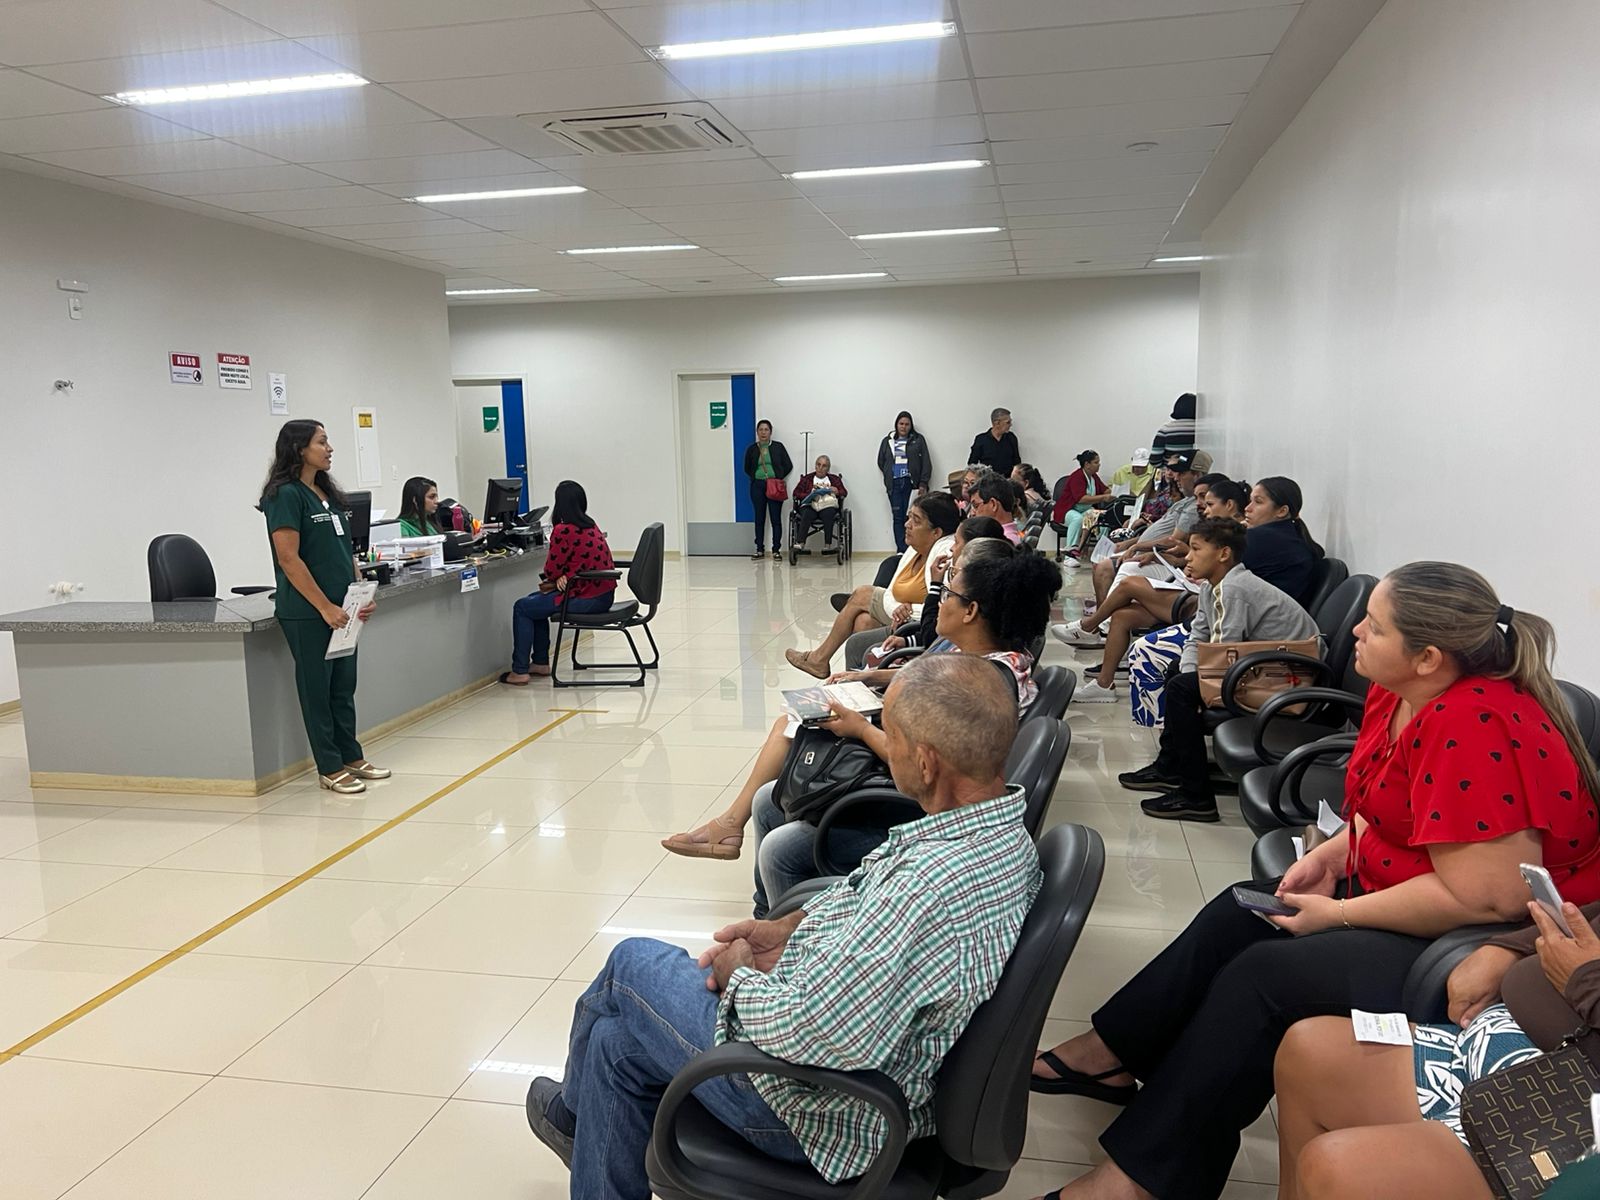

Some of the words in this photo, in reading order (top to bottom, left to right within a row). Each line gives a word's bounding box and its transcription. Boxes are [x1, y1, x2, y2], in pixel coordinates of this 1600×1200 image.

[177, 356, 196, 366] AVISO
[222, 356, 246, 364] ATENÇÃO
[1475, 1091, 1524, 1158] FIOM
[1517, 1074, 1567, 1141] FIOM
